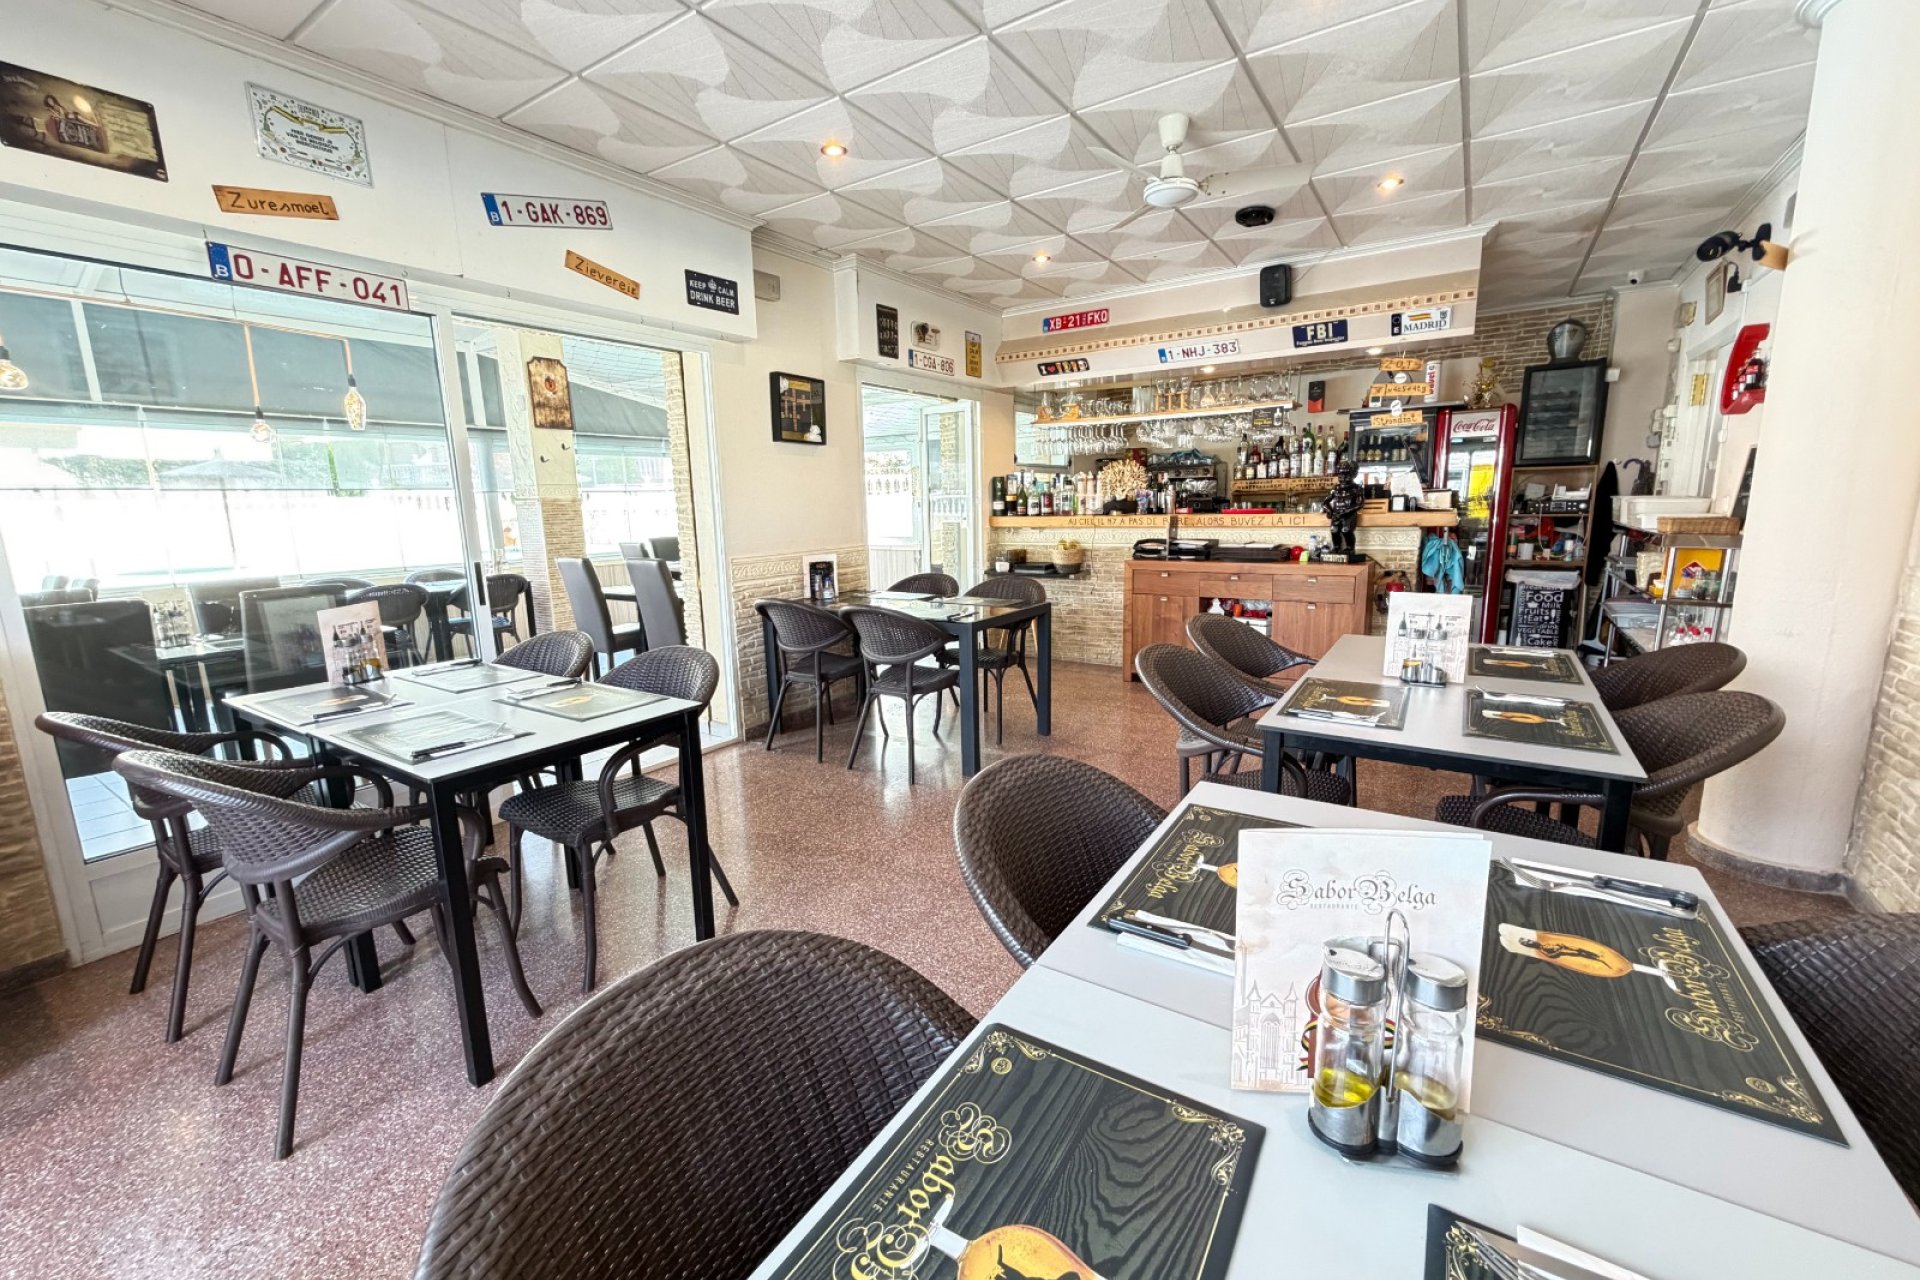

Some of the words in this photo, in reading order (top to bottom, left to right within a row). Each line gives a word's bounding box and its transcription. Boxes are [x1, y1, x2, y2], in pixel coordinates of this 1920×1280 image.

[501, 200, 608, 226] 1-GAK-869
[690, 280, 707, 290] KEEP
[717, 286, 735, 297] CALM
[690, 290, 714, 304] DRINK
[716, 296, 735, 309] BEER
[1306, 323, 1333, 341] FBI
[1403, 319, 1448, 333] MADRID
[1168, 342, 1237, 360] 1-NHJ-383
[1128, 516, 1142, 526] PAS
[1197, 516, 1225, 526] ALORS
[1230, 516, 1266, 526] BUVEZ
[1289, 516, 1306, 526] ICI
[1525, 591, 1564, 603] Food
[1276, 868, 1357, 911] Sabor
[1354, 869, 1437, 916] Belga
[897, 1101, 1013, 1225] Sabor
[871, 1138, 935, 1214] RESTAURANTE
